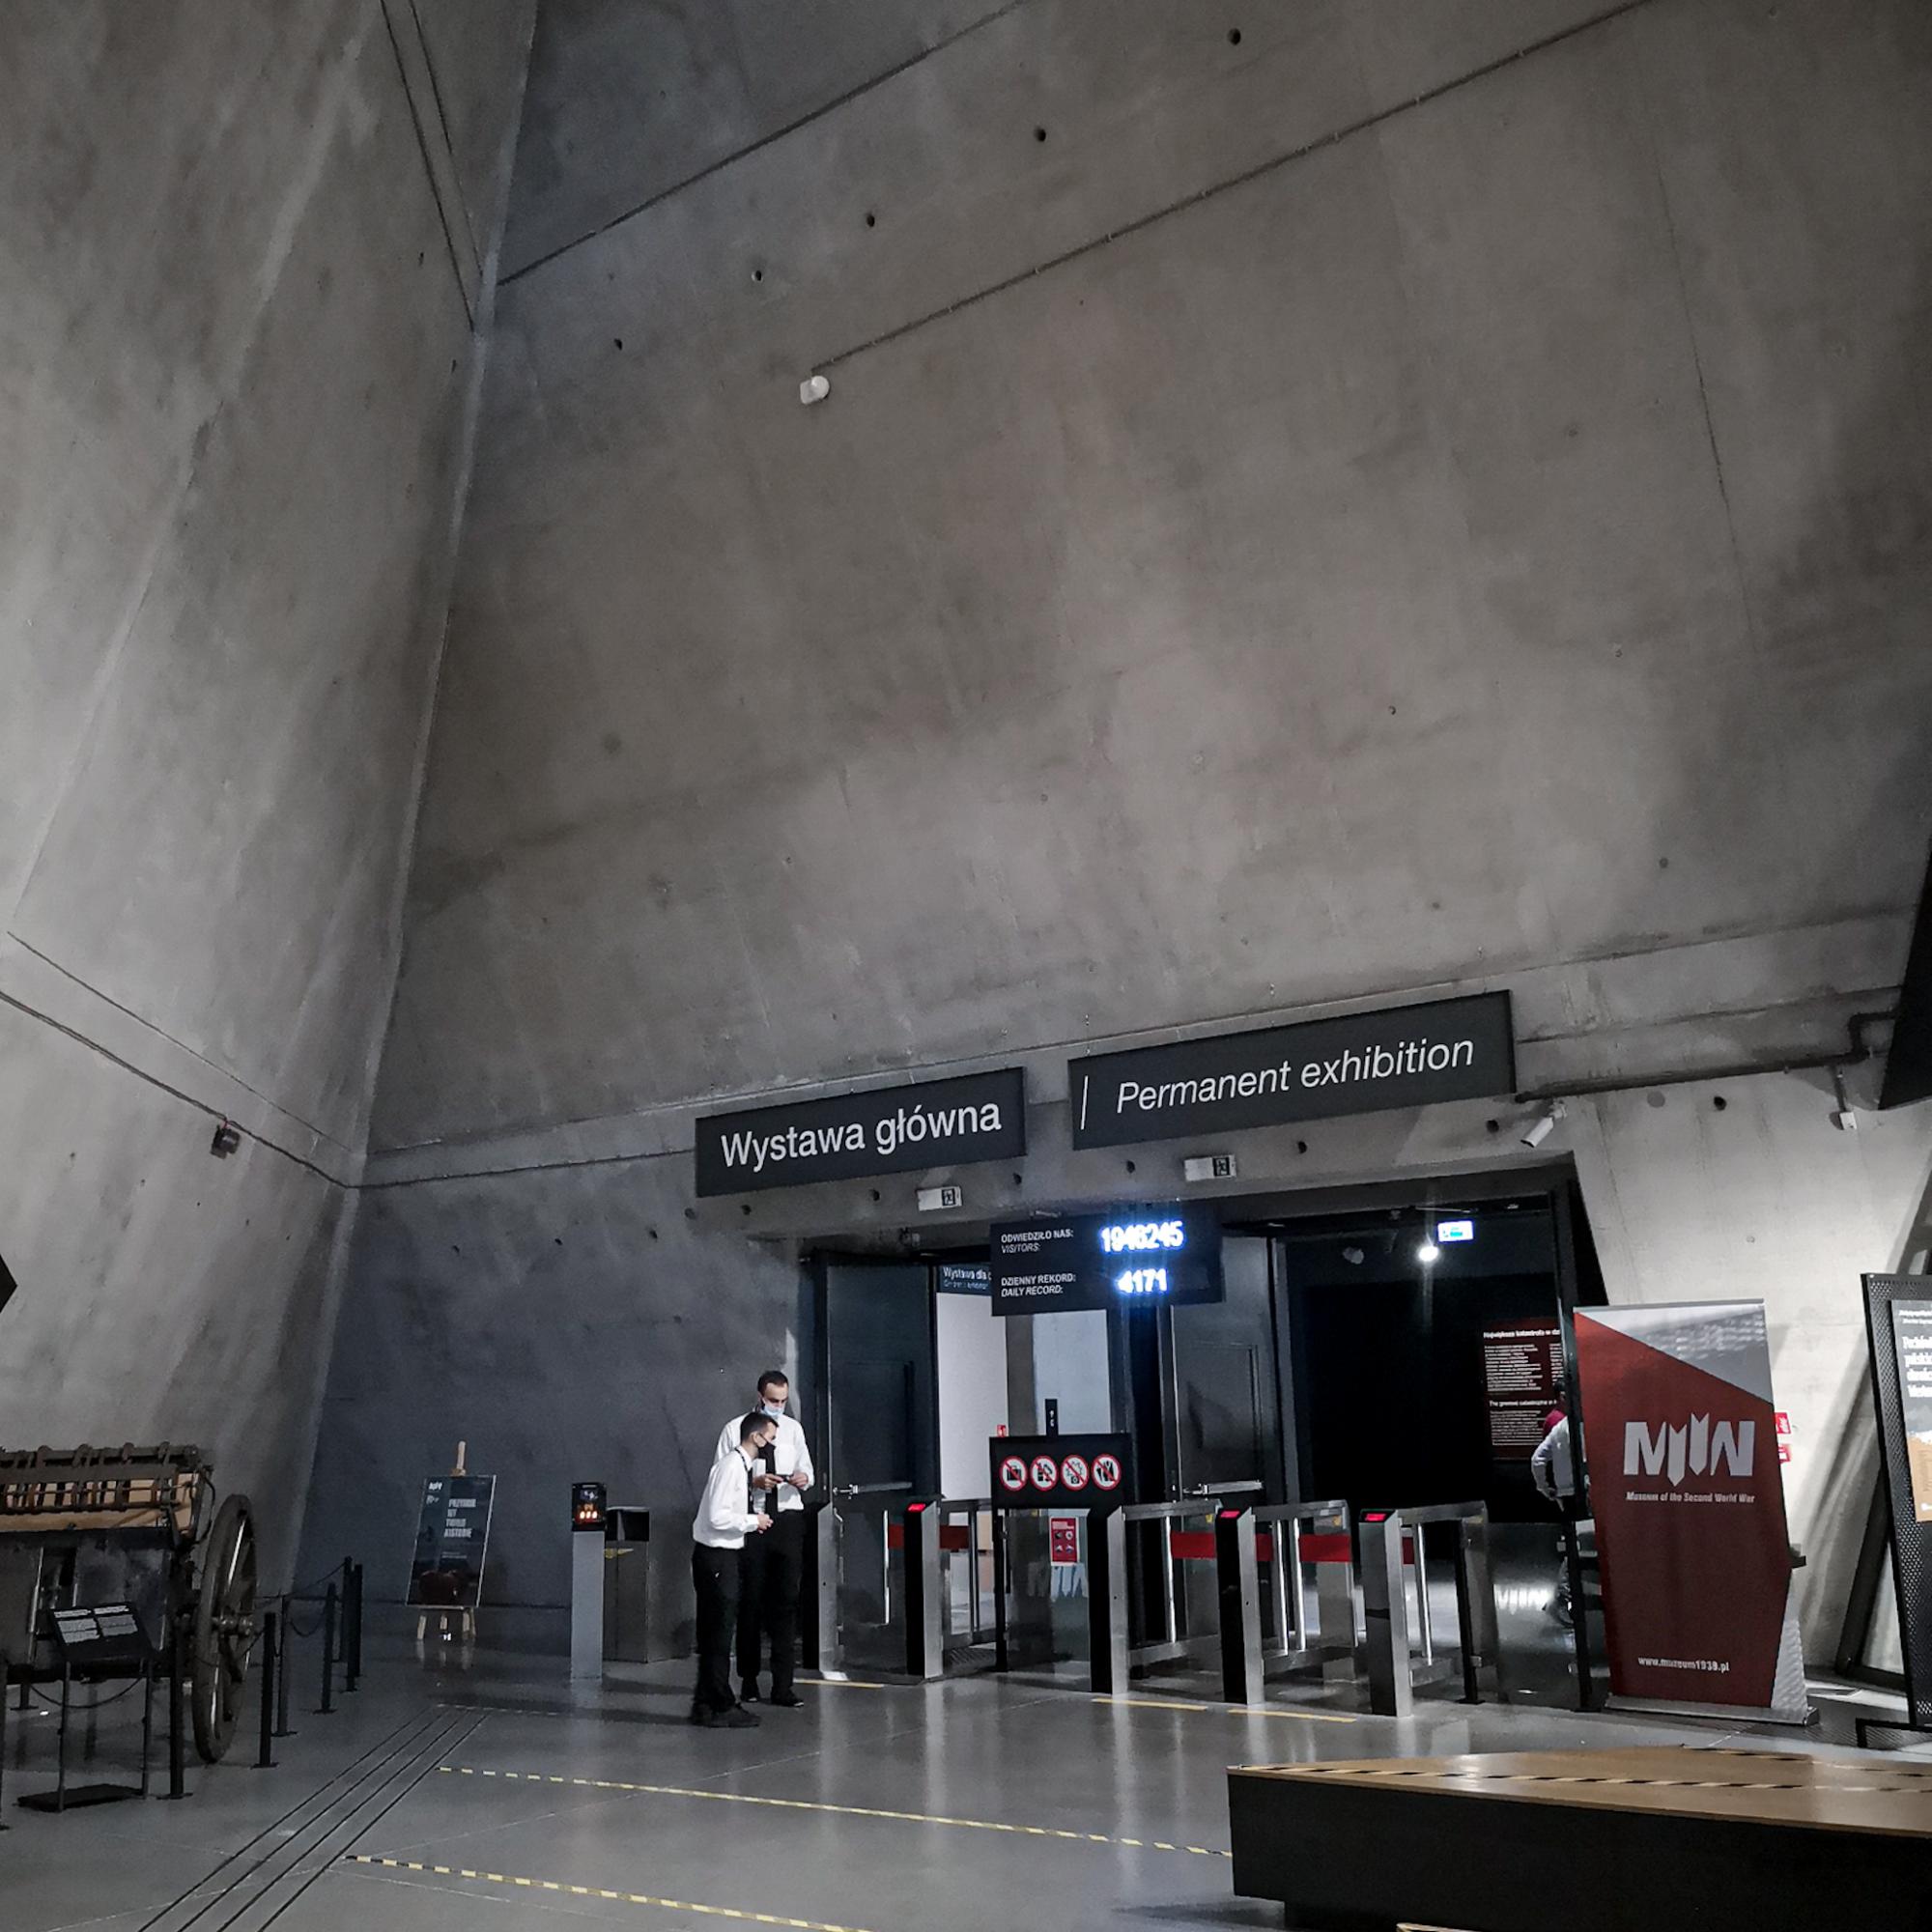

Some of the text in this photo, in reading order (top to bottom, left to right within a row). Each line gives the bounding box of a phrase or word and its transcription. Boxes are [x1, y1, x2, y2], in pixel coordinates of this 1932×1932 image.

[1116, 1037, 1474, 1114] Permanent exhibition
[721, 1102, 1003, 1173] Wystawa główna
[1053, 1229, 1074, 1239] NAS:
[1001, 1275, 1037, 1287] DZIENNY
[1037, 1273, 1076, 1284] REKORD:
[1117, 1267, 1168, 1293] 4171
[1001, 1285, 1064, 1297] DAILY RECORD:
[1660, 1492, 1668, 1501] of
[1669, 1492, 1683, 1502] the
[1684, 1492, 1713, 1503] Second
[1714, 1493, 1738, 1503] World
[1738, 1493, 1755, 1504] War
